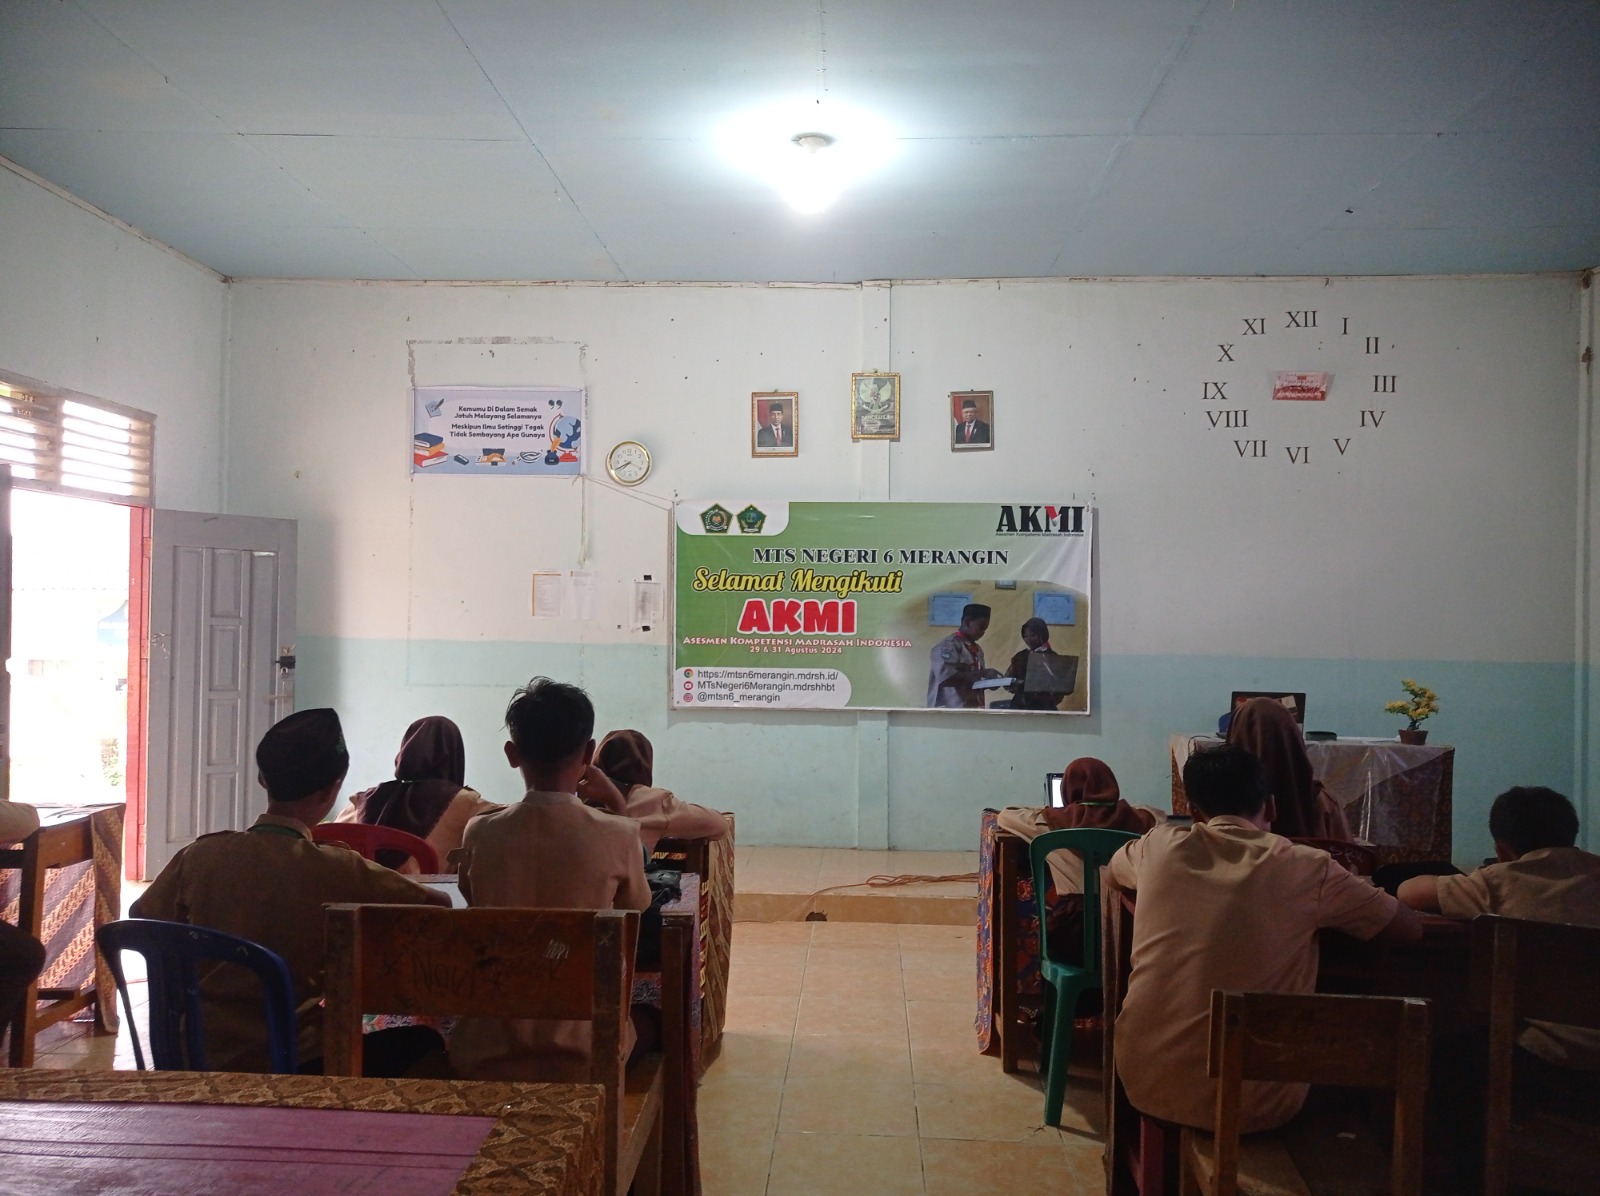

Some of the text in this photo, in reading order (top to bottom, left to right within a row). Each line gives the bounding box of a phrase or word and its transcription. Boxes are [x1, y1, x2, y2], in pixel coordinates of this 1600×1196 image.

[1242, 318, 1266, 335] XI
[1285, 310, 1318, 328] XII
[1342, 317, 1349, 335] I
[1217, 344, 1235, 362] X
[1365, 337, 1380, 354] II
[1202, 382, 1228, 400] IX
[1373, 375, 1397, 393] III
[1205, 409, 1249, 428] VIII
[1359, 410, 1386, 428] IV
[1233, 440, 1267, 458] VII
[1285, 446, 1309, 464] VI
[1333, 438, 1351, 456] V
[996, 506, 1085, 532] AKMI
[753, 548, 1010, 565] MTS NEGERI 6 MERANGIN
[692, 567, 903, 599] Selamat Mengikuti
[738, 599, 857, 635] AKMI
[683, 636, 912, 648] ASESMEN KOMPETENSI MADRASAH INDONESIA
[784, 646, 818, 655] Agustus
[697, 669, 839, 682] https://mtsn6merangin.mdrsh.id/
[697, 681, 836, 692] MTsNegeri6Merangin.mdrshhbt
[697, 692, 781, 704] @mtsn6_merangin
